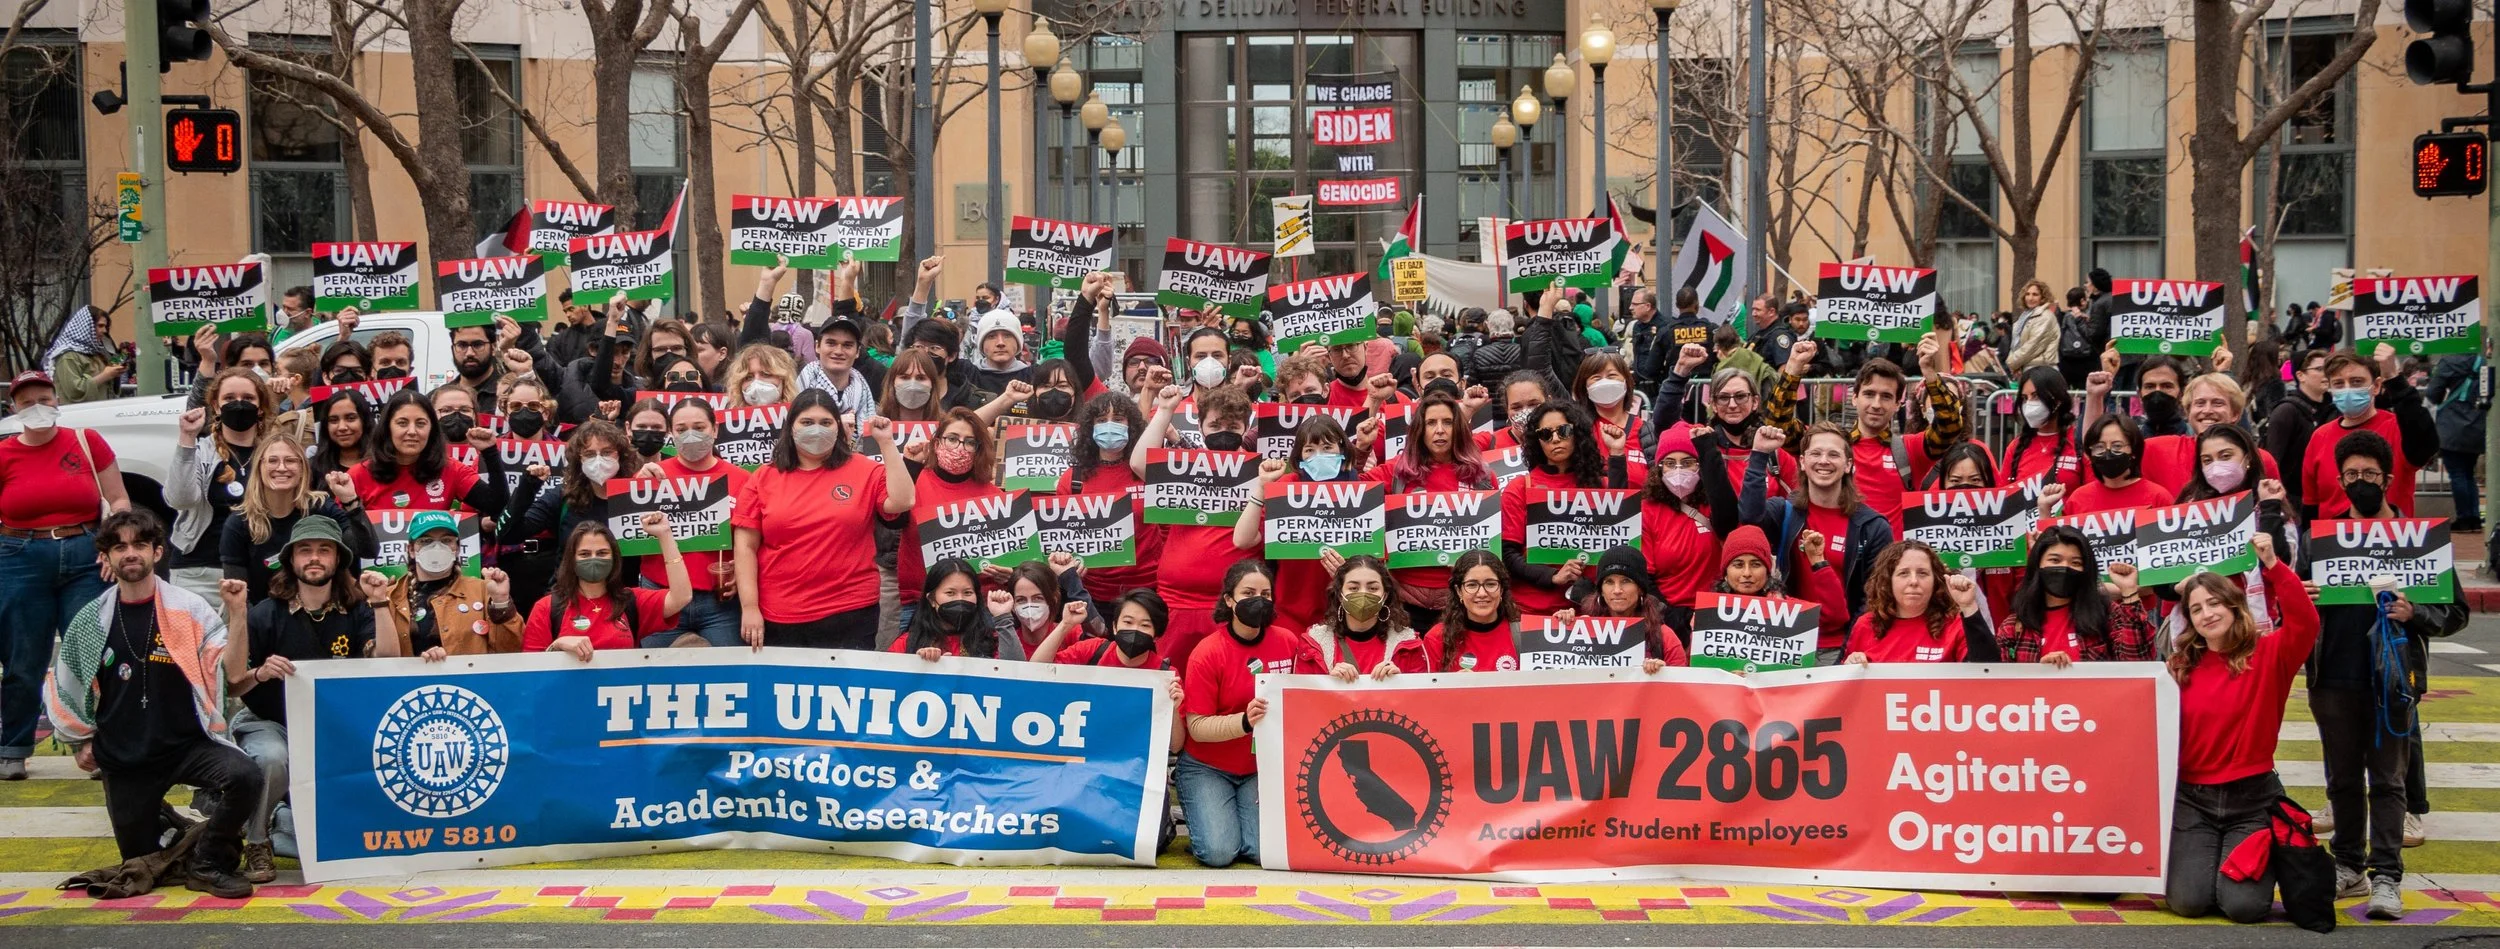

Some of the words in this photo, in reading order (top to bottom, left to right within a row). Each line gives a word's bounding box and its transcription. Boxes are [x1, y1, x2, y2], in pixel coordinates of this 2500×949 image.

[1200, 0, 1297, 17] DELLUMS
[1314, 0, 1408, 15] FEDERAL
[1422, 0, 1527, 17] BUILDING
[1317, 86, 1337, 101] WE
[1340, 85, 1392, 101] CHARGE
[1318, 113, 1391, 142] BIDEN
[217, 124, 233, 160] 0
[1339, 155, 1373, 171] WITH
[2466, 143, 2482, 180] 0
[1320, 182, 1396, 201] GENOCIDE
[545, 202, 603, 227] UAW
[752, 198, 822, 223] UAW
[835, 199, 889, 219] AW
[742, 228, 826, 242] PERMANENT
[1031, 220, 1099, 248] UAW
[1524, 218, 1595, 245] UAW
[587, 232, 653, 259] UAW
[742, 240, 826, 255] CEASEFIRE
[840, 238, 889, 248] SEFIRE
[331, 243, 400, 266] UAW
[1018, 248, 1100, 266] PERMANENT
[1185, 242, 1255, 273] UAW
[1517, 250, 1600, 264] PERMANENT
[170, 265, 244, 290] UAW
[458, 257, 527, 282] UAW
[580, 262, 660, 278] PERMANENT
[1018, 259, 1098, 277] CEASEFIR
[1519, 262, 1601, 276] CEASEFIRE
[323, 274, 407, 284] PERMANENT
[581, 274, 661, 290] CEASEFIRE
[1171, 270, 1254, 292] PERMANENT
[1286, 274, 1353, 305] UAW
[1841, 266, 1919, 293] UAW
[324, 286, 407, 296] CEASEFIRE
[452, 286, 534, 300] PERMANENT
[1170, 282, 1252, 305] CEASEFIRE
[2132, 281, 2209, 306] UAW
[2375, 278, 2459, 304] UAW
[163, 296, 252, 309] PERMANENT
[453, 297, 536, 312] CEASEFIRE
[1828, 298, 1922, 314] PERMANENT
[164, 307, 254, 322] CEASEFIRE
[1282, 305, 1362, 325] PERMANENT
[1828, 311, 1921, 328] CEASEFIRE
[2121, 314, 2213, 326] PERMANENT
[2366, 313, 2466, 325] PERMANENT
[1284, 316, 1365, 337] CEASEFIRE
[1674, 327, 1706, 339] POLICE
[2121, 326, 2212, 340] CEASEFIRE
[2366, 326, 2466, 338] CEASEFIRE
[1168, 451, 1244, 477] UAW
[630, 476, 710, 504] UAW
[1156, 483, 1249, 497] PERMANENT
[1287, 484, 1366, 508] UAW
[936, 493, 1012, 527] UAW
[1039, 495, 1114, 521] UAW
[1156, 497, 1248, 511] CEASEFIRE
[1406, 492, 1483, 518] UAW
[1547, 491, 1624, 515] UAW
[1924, 490, 2005, 517] UAW
[621, 510, 717, 525] PEANENT
[1277, 518, 1372, 528] PERMANENT
[2157, 499, 2235, 531] UAW
[932, 525, 1024, 550] PERMANENT
[1041, 528, 1121, 541] ERMANENT
[1277, 531, 1372, 542] CEASEFIRE
[1397, 525, 1489, 538] PERMANENT
[1538, 524, 1629, 535] PERMANENT
[1915, 525, 2013, 538] PERMANENT
[2337, 521, 2428, 548] UAW
[1044, 540, 1122, 555] EASEFIRE
[1397, 537, 1489, 551] CEASEFIRE
[1930, 538, 2014, 552] EASEFIRE
[2149, 531, 2245, 556] PERMANENT
[2150, 543, 2247, 570] CEASEFIRE
[2326, 559, 2436, 570] PERMANENT
[1718, 595, 1802, 627] UAW
[1544, 618, 1627, 645] UAW
[1704, 630, 1804, 650] PERMANENT
[1532, 653, 1632, 667] PERMANENT
[1704, 643, 1802, 665] CEASEFIRE
[598, 683, 748, 731] THE
[773, 683, 1001, 743] UNION
[1011, 701, 1091, 748] of
[1886, 689, 2096, 733] Educate.
[423, 725, 457, 737] LOCAL
[416, 741, 466, 778] UAW
[725, 750, 896, 789] Postdocs
[908, 760, 940, 790] &
[1472, 718, 1640, 804] UAW
[1657, 716, 1847, 803] 2865
[1886, 750, 2087, 803] Agitate.
[610, 789, 808, 829] Academic
[818, 796, 1060, 835] Researchers
[363, 828, 434, 851] UAW
[444, 824, 516, 846] 5810
[1477, 819, 1596, 842] Academic
[1605, 817, 1701, 840] Student
[1709, 817, 1848, 846] Employees
[1888, 810, 2144, 864] Organize.
